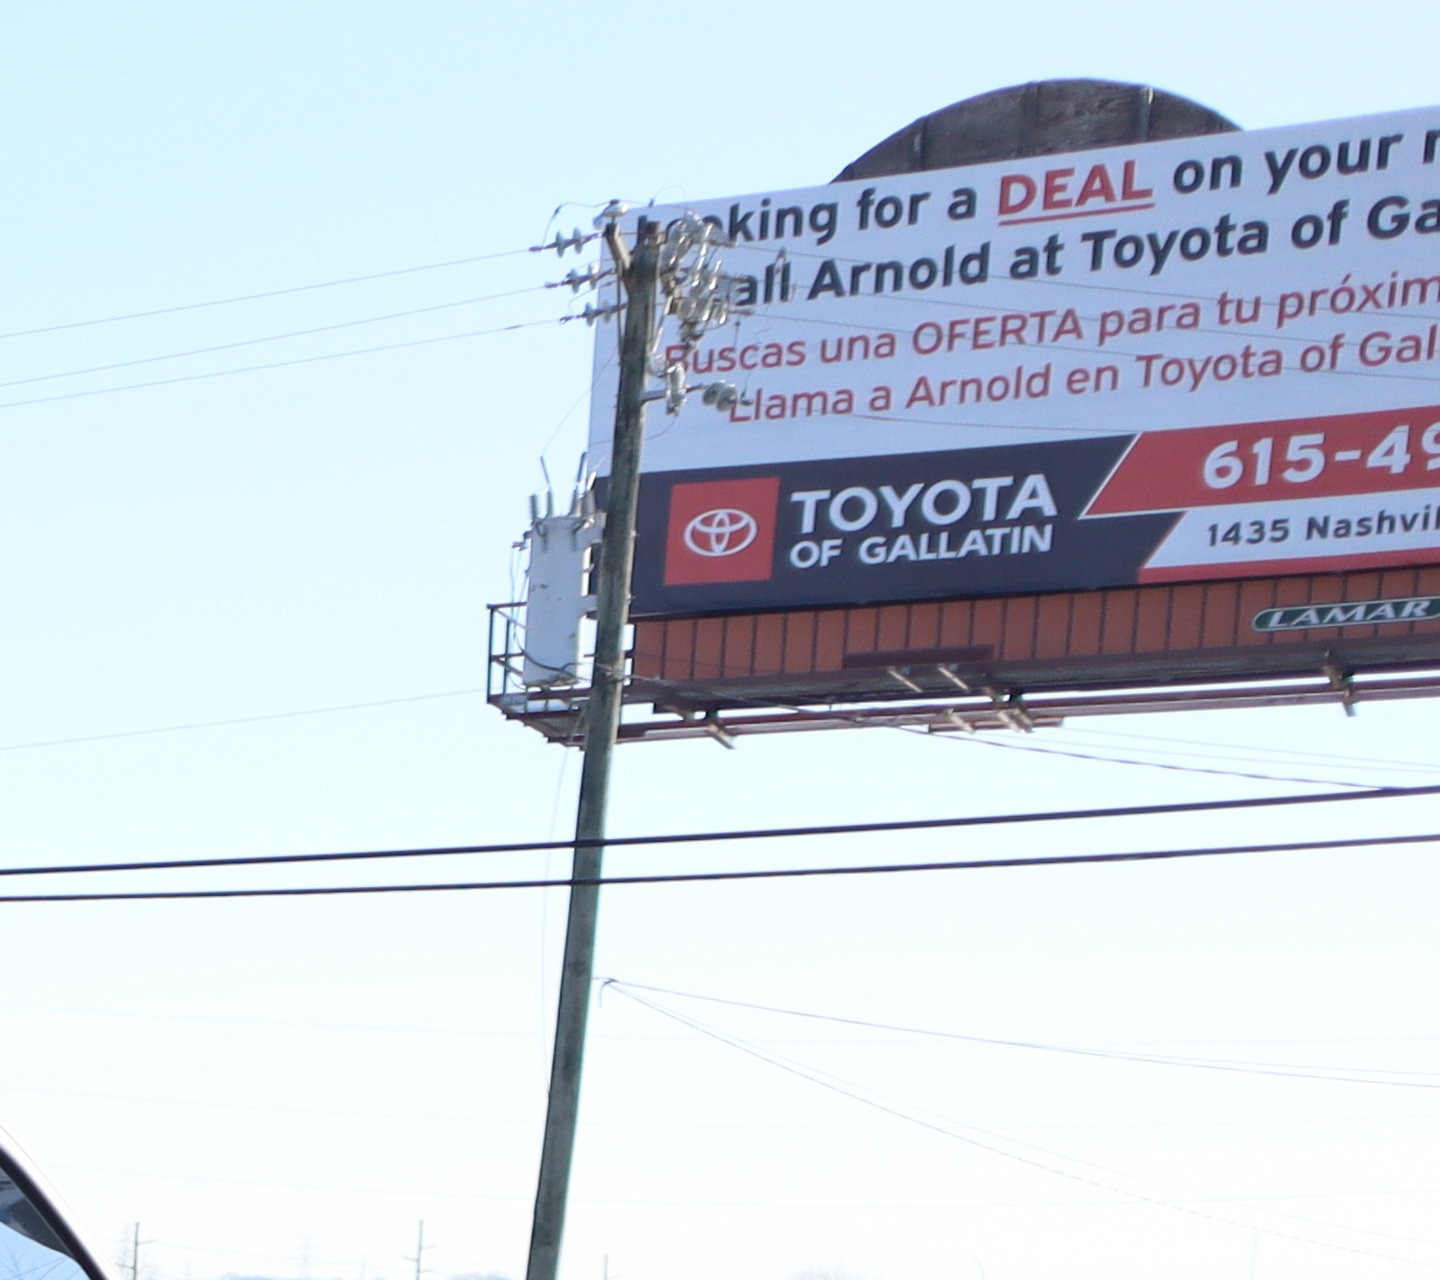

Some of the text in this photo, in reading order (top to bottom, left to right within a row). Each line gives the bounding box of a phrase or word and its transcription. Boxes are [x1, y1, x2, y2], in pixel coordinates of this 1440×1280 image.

[637, 197, 838, 248] Lking
[856, 187, 932, 231] for
[947, 186, 977, 220] a
[997, 159, 1154, 217] DEAL
[1172, 154, 1243, 195] on
[1264, 132, 1404, 196] your
[710, 261, 791, 307] all
[807, 241, 992, 301] Arnold
[1009, 232, 1065, 279] at
[1081, 213, 1270, 276] Toyota
[1291, 199, 1350, 250] of
[665, 341, 807, 375] Buscas
[819, 331, 897, 364] una
[911, 307, 1083, 356] OFERTA
[1097, 300, 1201, 347] para
[1217, 290, 1261, 326] tu
[729, 386, 854, 423] Llama
[868, 385, 892, 411] a
[905, 362, 1052, 409] Arnold
[1066, 366, 1119, 394] en
[1136, 344, 1284, 393] Toyota
[1299, 333, 1346, 374] of
[790, 473, 1059, 535] TOYOTA
[1207, 517, 1290, 547] 1435
[789, 523, 1054, 570] OF GALLATIN
[1267, 600, 1430, 628] LAMAR
